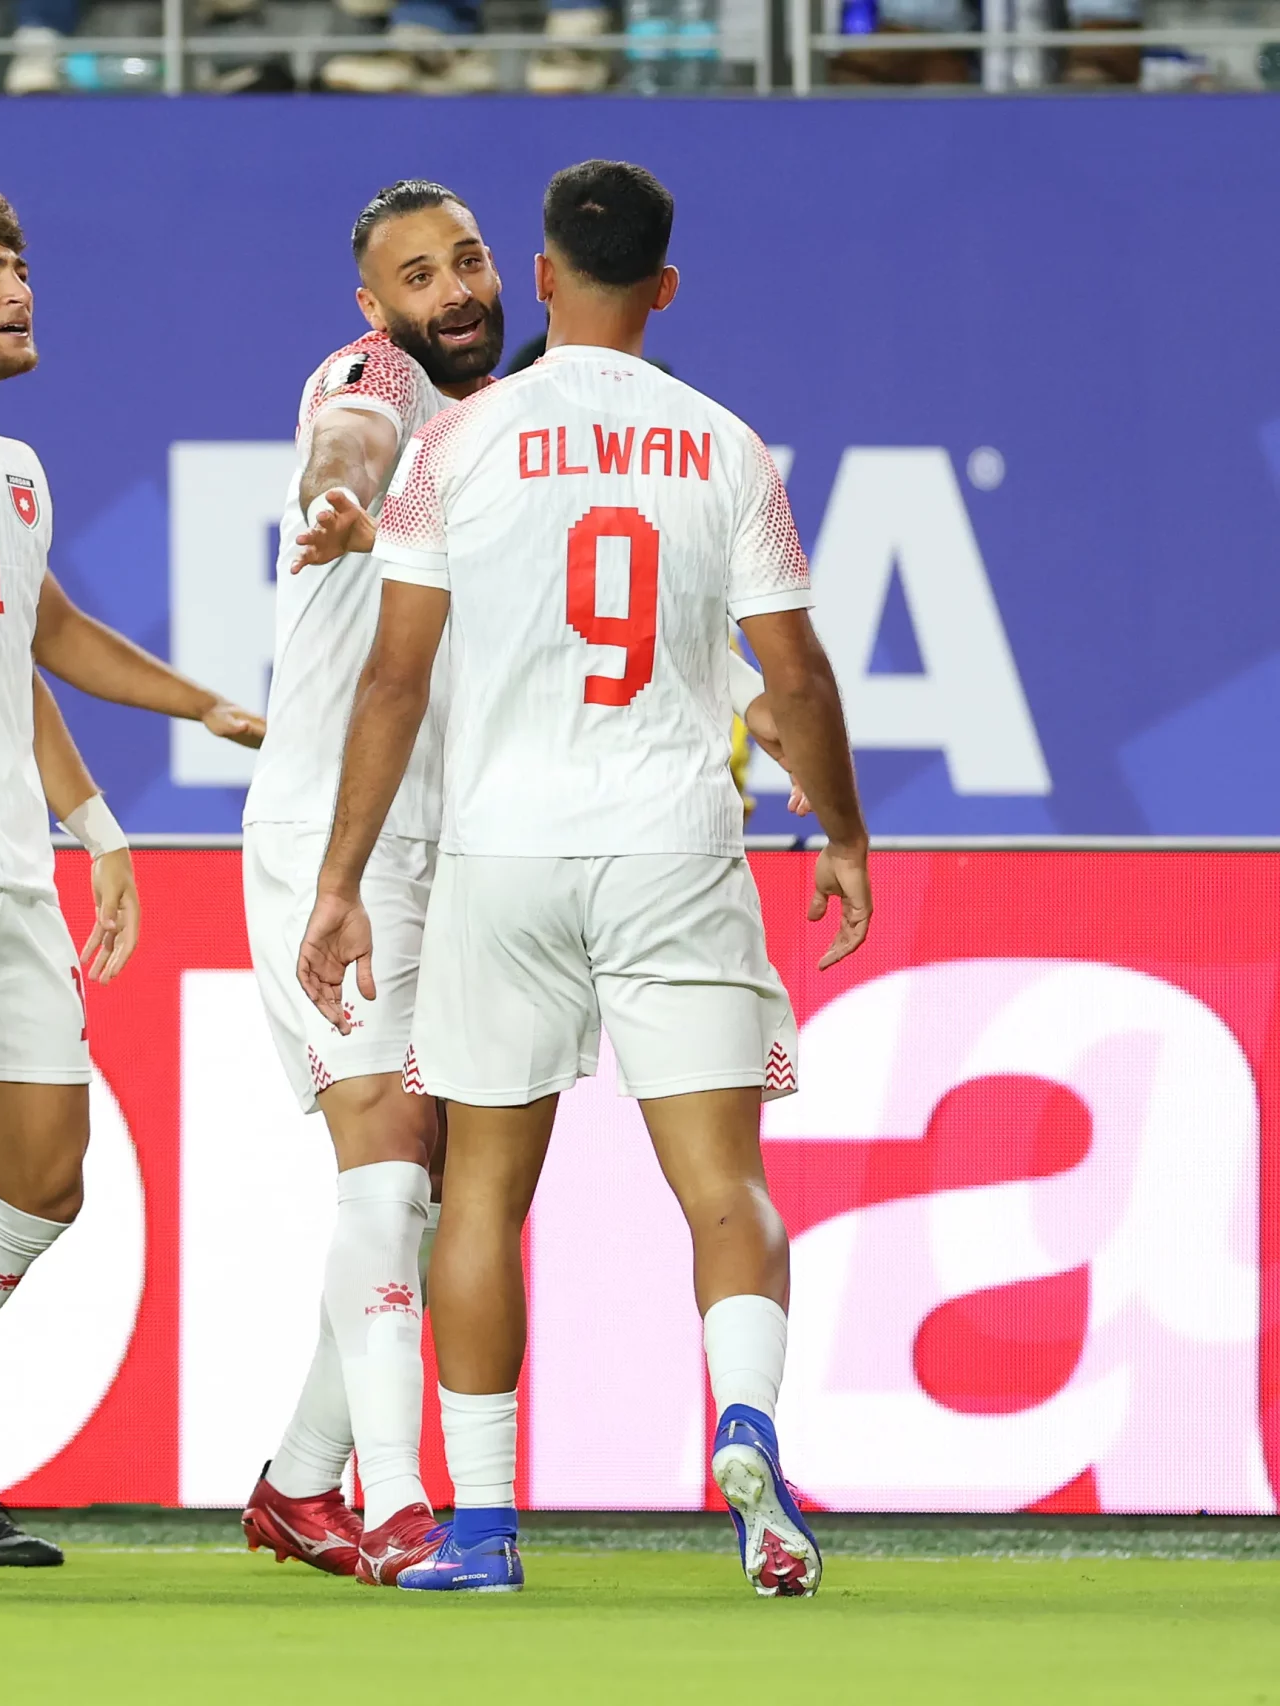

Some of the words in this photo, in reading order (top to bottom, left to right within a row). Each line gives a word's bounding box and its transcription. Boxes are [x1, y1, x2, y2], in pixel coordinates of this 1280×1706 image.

[518, 423, 711, 481] OLWAN
[9, 476, 32, 487] JORDAN
[566, 506, 660, 707] 9
[330, 1020, 365, 1033] KME
[468, 1573, 488, 1581] ZOOM
